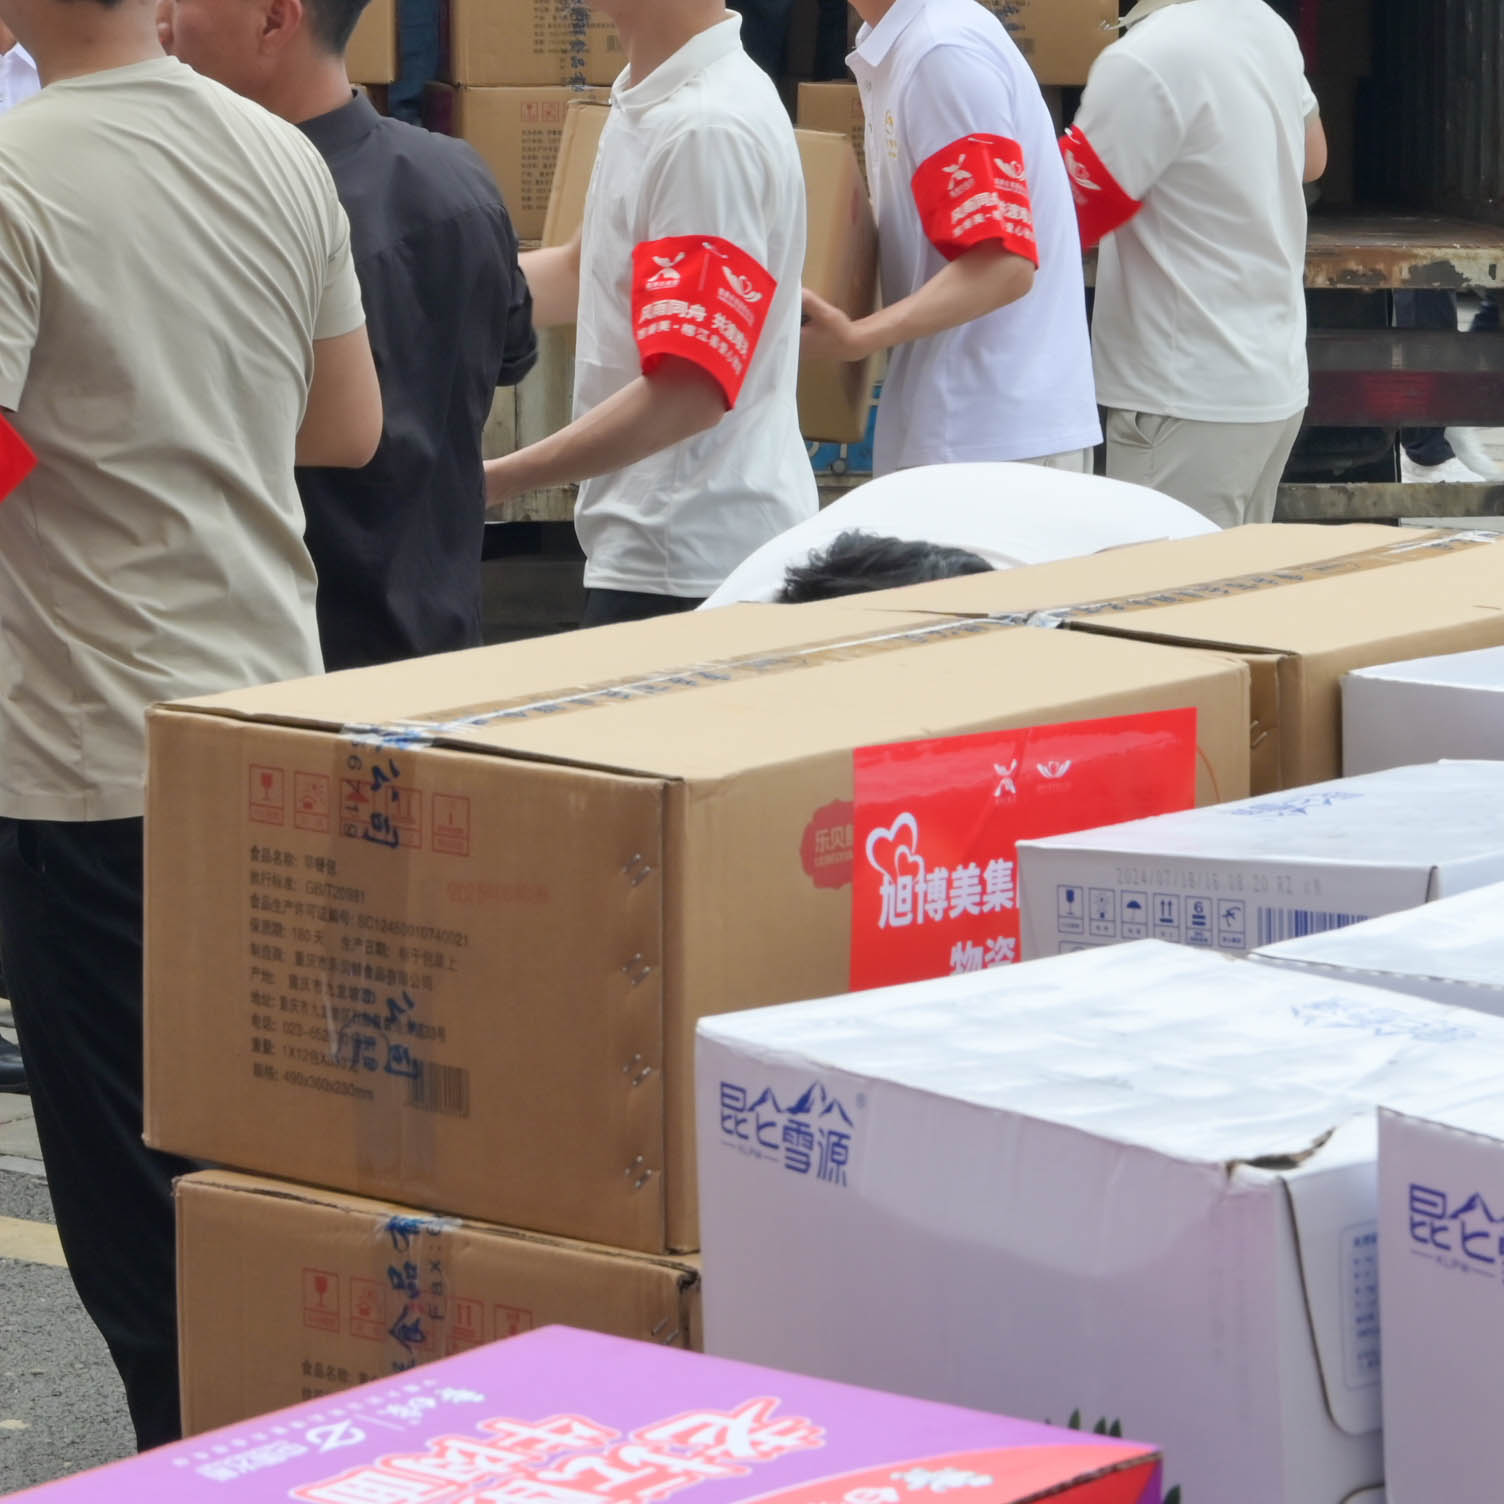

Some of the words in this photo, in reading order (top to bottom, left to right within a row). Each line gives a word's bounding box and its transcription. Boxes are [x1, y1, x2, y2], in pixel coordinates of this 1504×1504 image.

[879, 857, 1020, 929] 旭博美集
[720, 1080, 854, 1188] 昆仑雪源
[461, 1396, 826, 1504] 老坛酸
